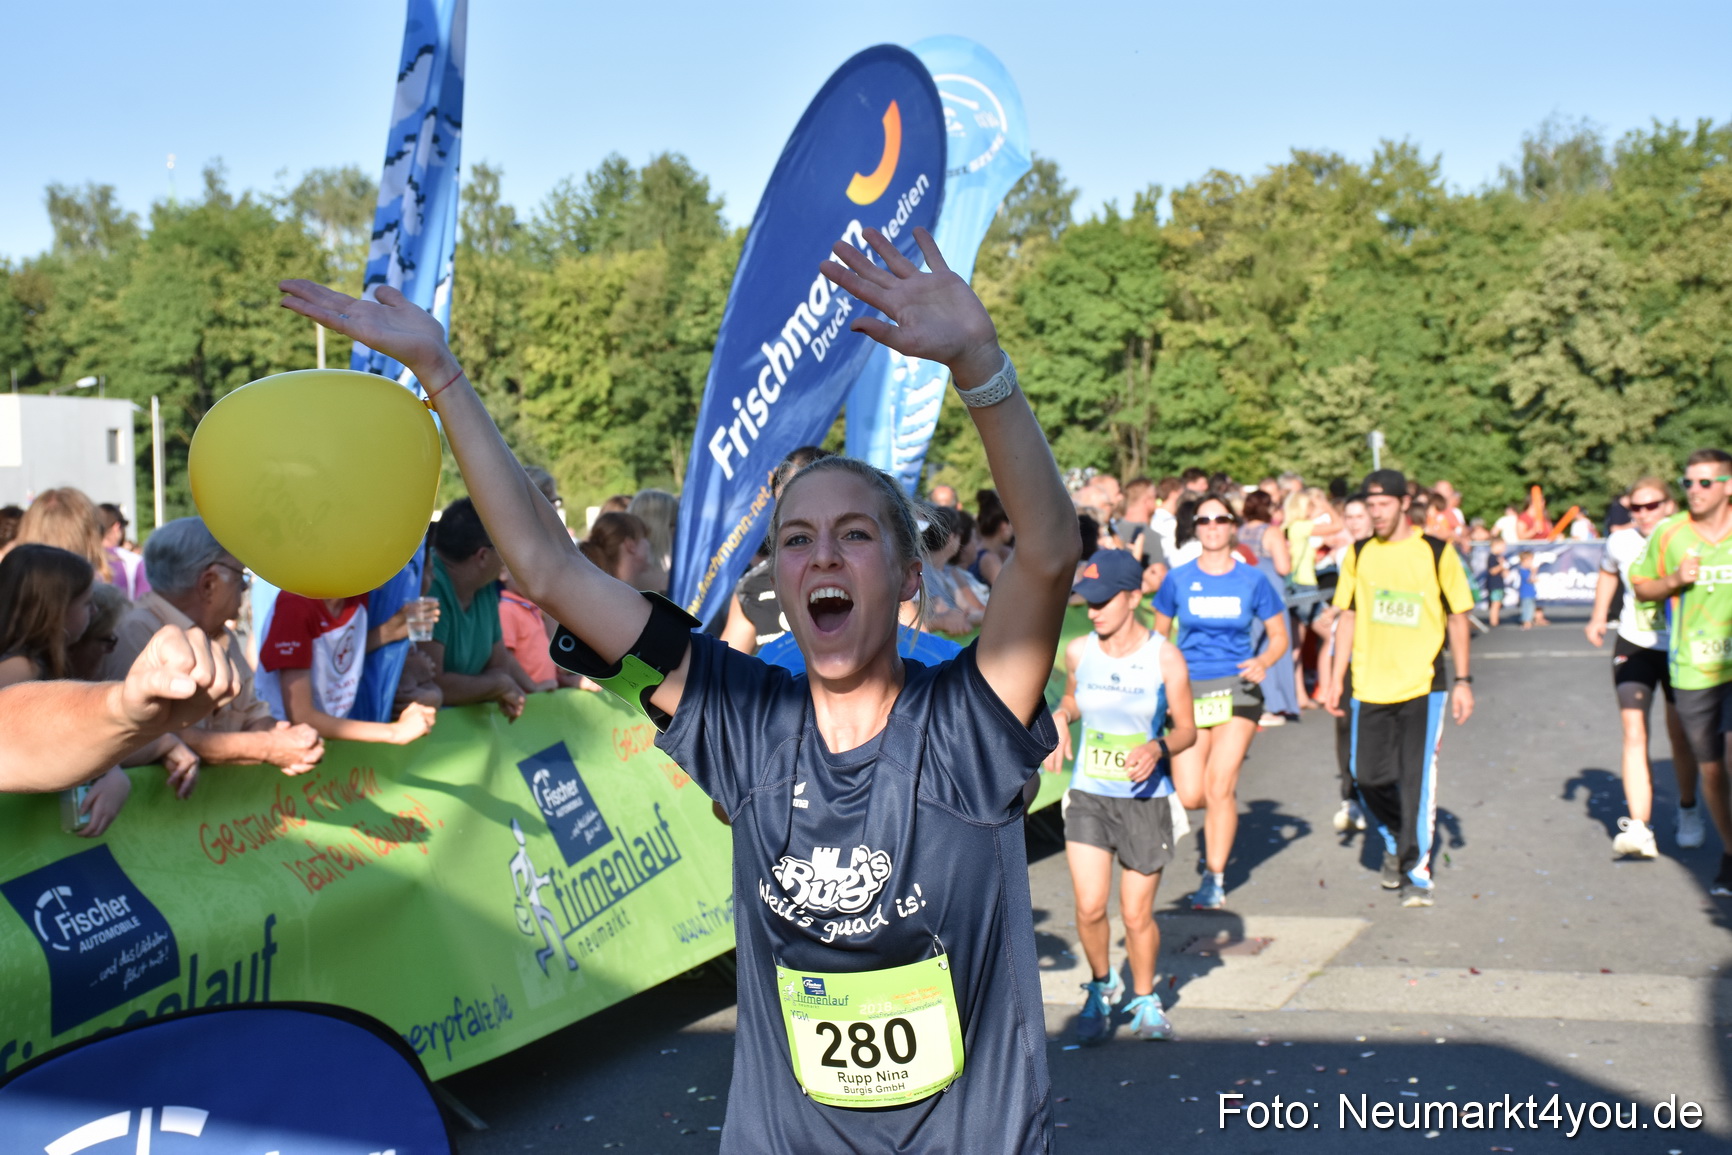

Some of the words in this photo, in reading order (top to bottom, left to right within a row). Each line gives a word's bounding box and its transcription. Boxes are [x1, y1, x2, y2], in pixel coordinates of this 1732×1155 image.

[810, 296, 853, 362] Druck
[1092, 748, 1126, 768] 176
[543, 779, 580, 810] Fischer
[200, 783, 307, 866] Gesunde
[550, 802, 682, 939] firmenlauf
[54, 894, 131, 941] Fischer
[759, 878, 815, 928] Weil's
[896, 883, 927, 918] is!
[79, 915, 142, 953] AUTOMOBILE
[578, 908, 632, 959] neumarkt
[797, 991, 849, 1007] firmenlauf
[859, 1001, 893, 1015] 2018
[815, 1017, 918, 1069] 280
[837, 1071, 872, 1085] Rupp
[876, 1070, 909, 1083] Nina
[843, 1085, 874, 1096] Burgis
[875, 1083, 905, 1094] GmbH
